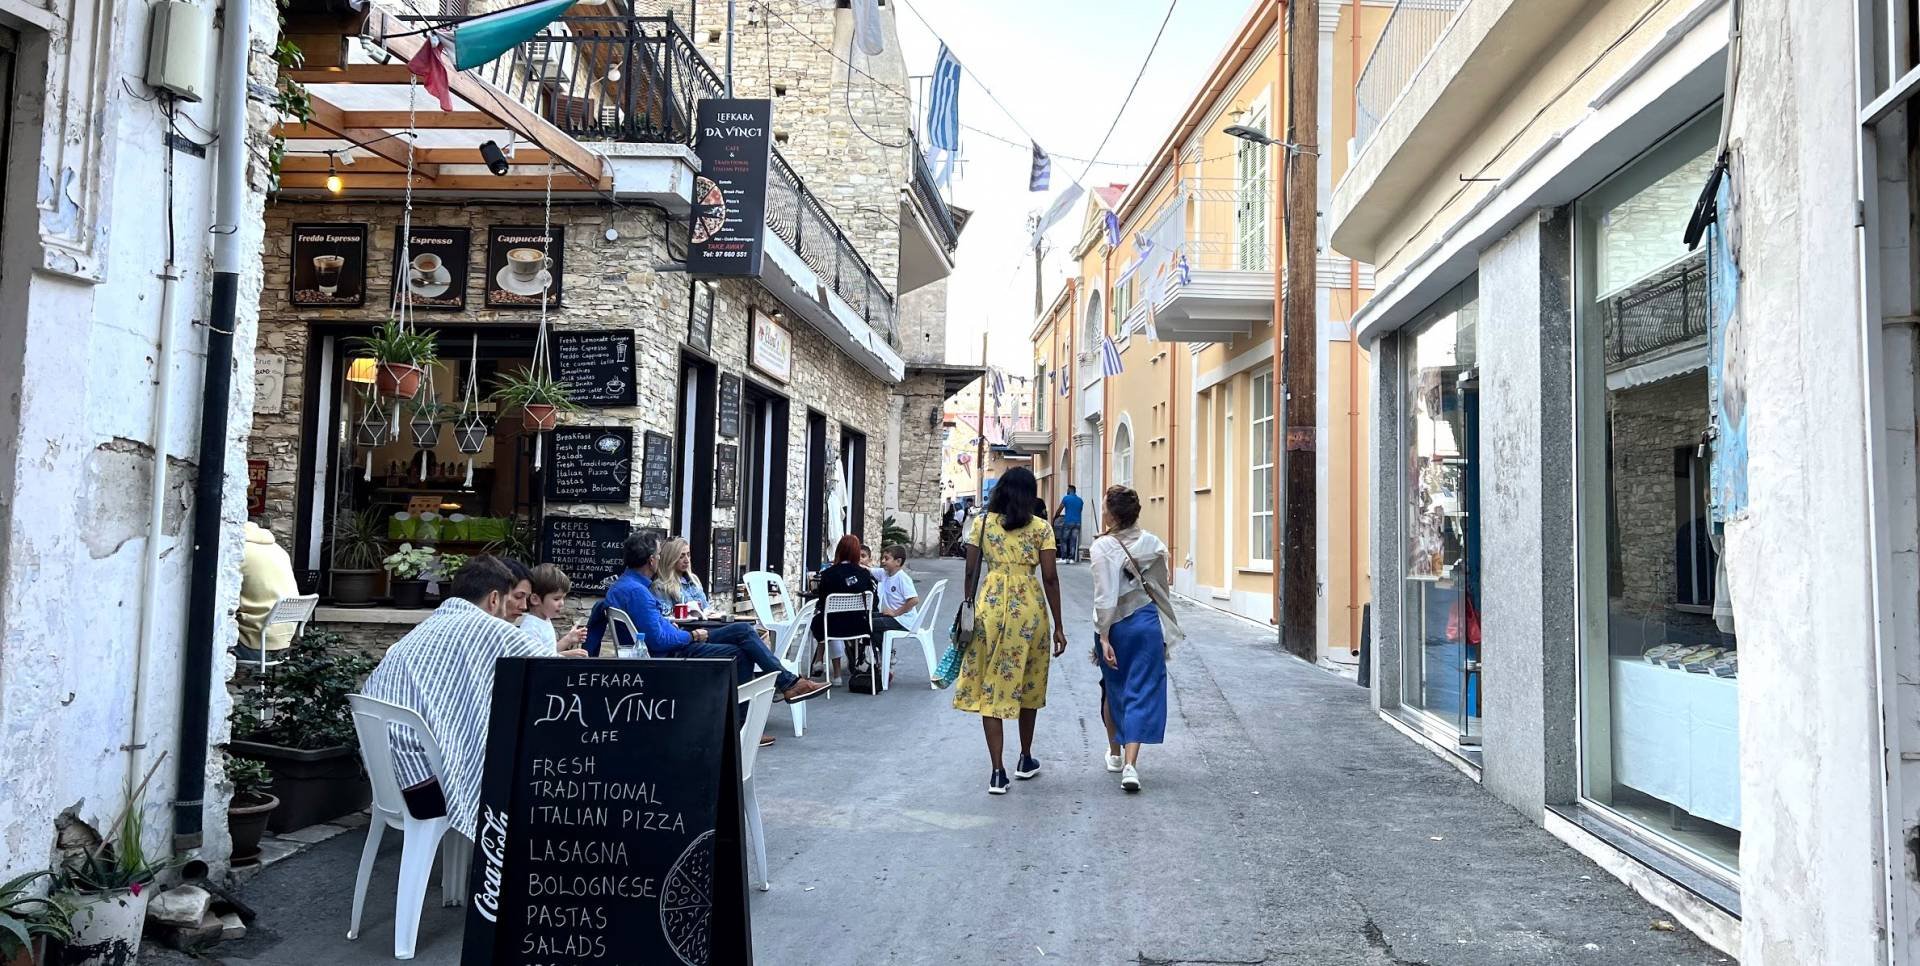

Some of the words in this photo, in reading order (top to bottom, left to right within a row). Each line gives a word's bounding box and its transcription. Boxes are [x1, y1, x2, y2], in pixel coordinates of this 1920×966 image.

[717, 113, 754, 123] LEFKARA
[704, 127, 724, 138] DA
[725, 126, 762, 138] VINCI
[298, 234, 325, 242] Freddo
[326, 234, 360, 243] Espresso
[410, 236, 453, 245] Espresso
[497, 234, 553, 244] Cappuccino
[559, 336, 577, 344] Fresh
[556, 432, 592, 441] Breakfast
[576, 444, 592, 452] pies
[556, 451, 583, 460] Salads
[556, 469, 583, 477] Italian
[588, 467, 609, 476] Pizza
[556, 478, 584, 486] Pastas
[553, 521, 589, 531] CREPES
[553, 531, 591, 539] WAFFLES
[601, 541, 625, 549] CAKES
[552, 547, 576, 555] FRESH
[580, 548, 596, 556] PIES
[552, 556, 597, 565] TRADITIONAL
[576, 564, 614, 573] LEMONADE
[567, 673, 644, 687] LEFKARA
[534, 693, 588, 727] DA
[605, 692, 676, 723] VINCI
[581, 730, 619, 743] CAFE
[532, 756, 596, 776] FRESH
[530, 780, 662, 805] TRADITIONAL
[530, 806, 607, 827] ITALIAN
[622, 808, 685, 835] PIZZA
[529, 840, 628, 867] LASAGNA
[528, 873, 658, 898] BOLOGNESE
[527, 905, 607, 930] PASTAS
[521, 933, 606, 958] SALADS
